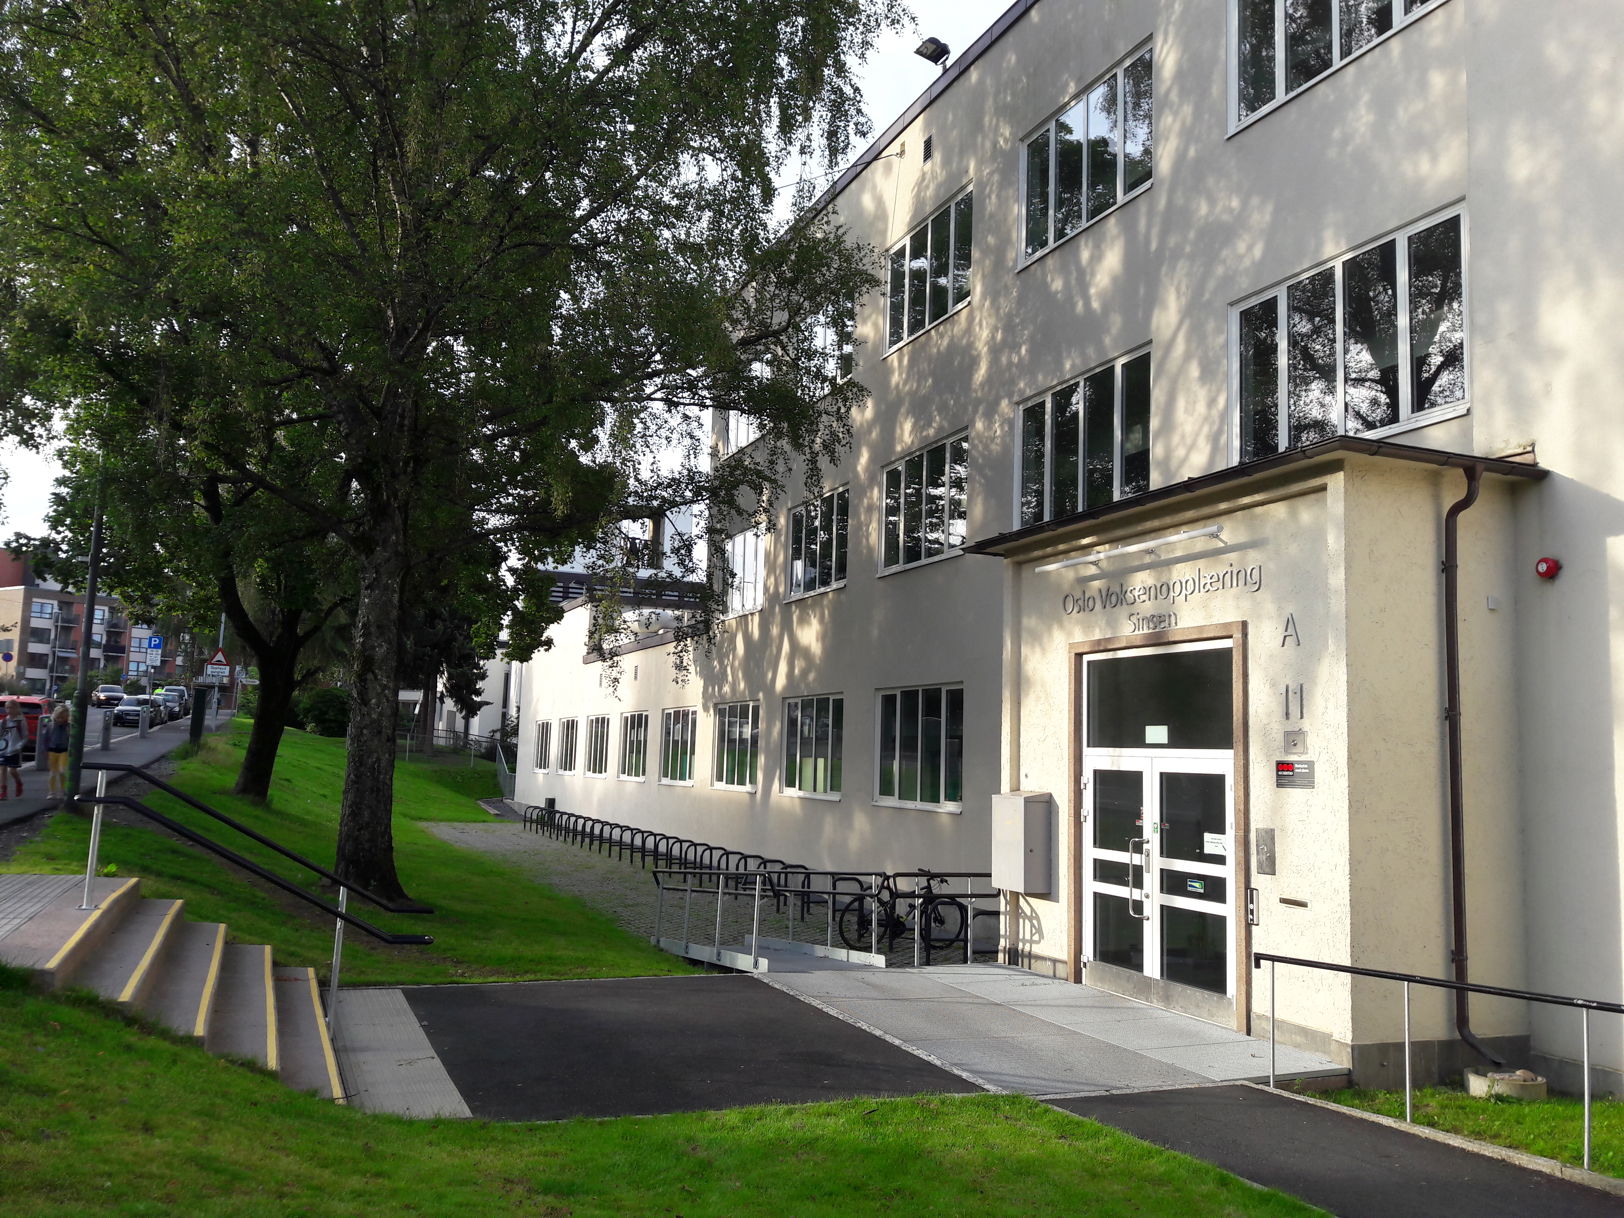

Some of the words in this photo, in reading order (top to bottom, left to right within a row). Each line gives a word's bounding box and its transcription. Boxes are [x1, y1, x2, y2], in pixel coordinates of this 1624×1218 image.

[1063, 590, 1096, 615] Oslo
[1098, 562, 1263, 610] Voksenopplæring
[1128, 611, 1178, 634] Sinsen
[1281, 612, 1301, 648] A
[151, 637, 160, 648] P
[1282, 682, 1305, 721] 11
